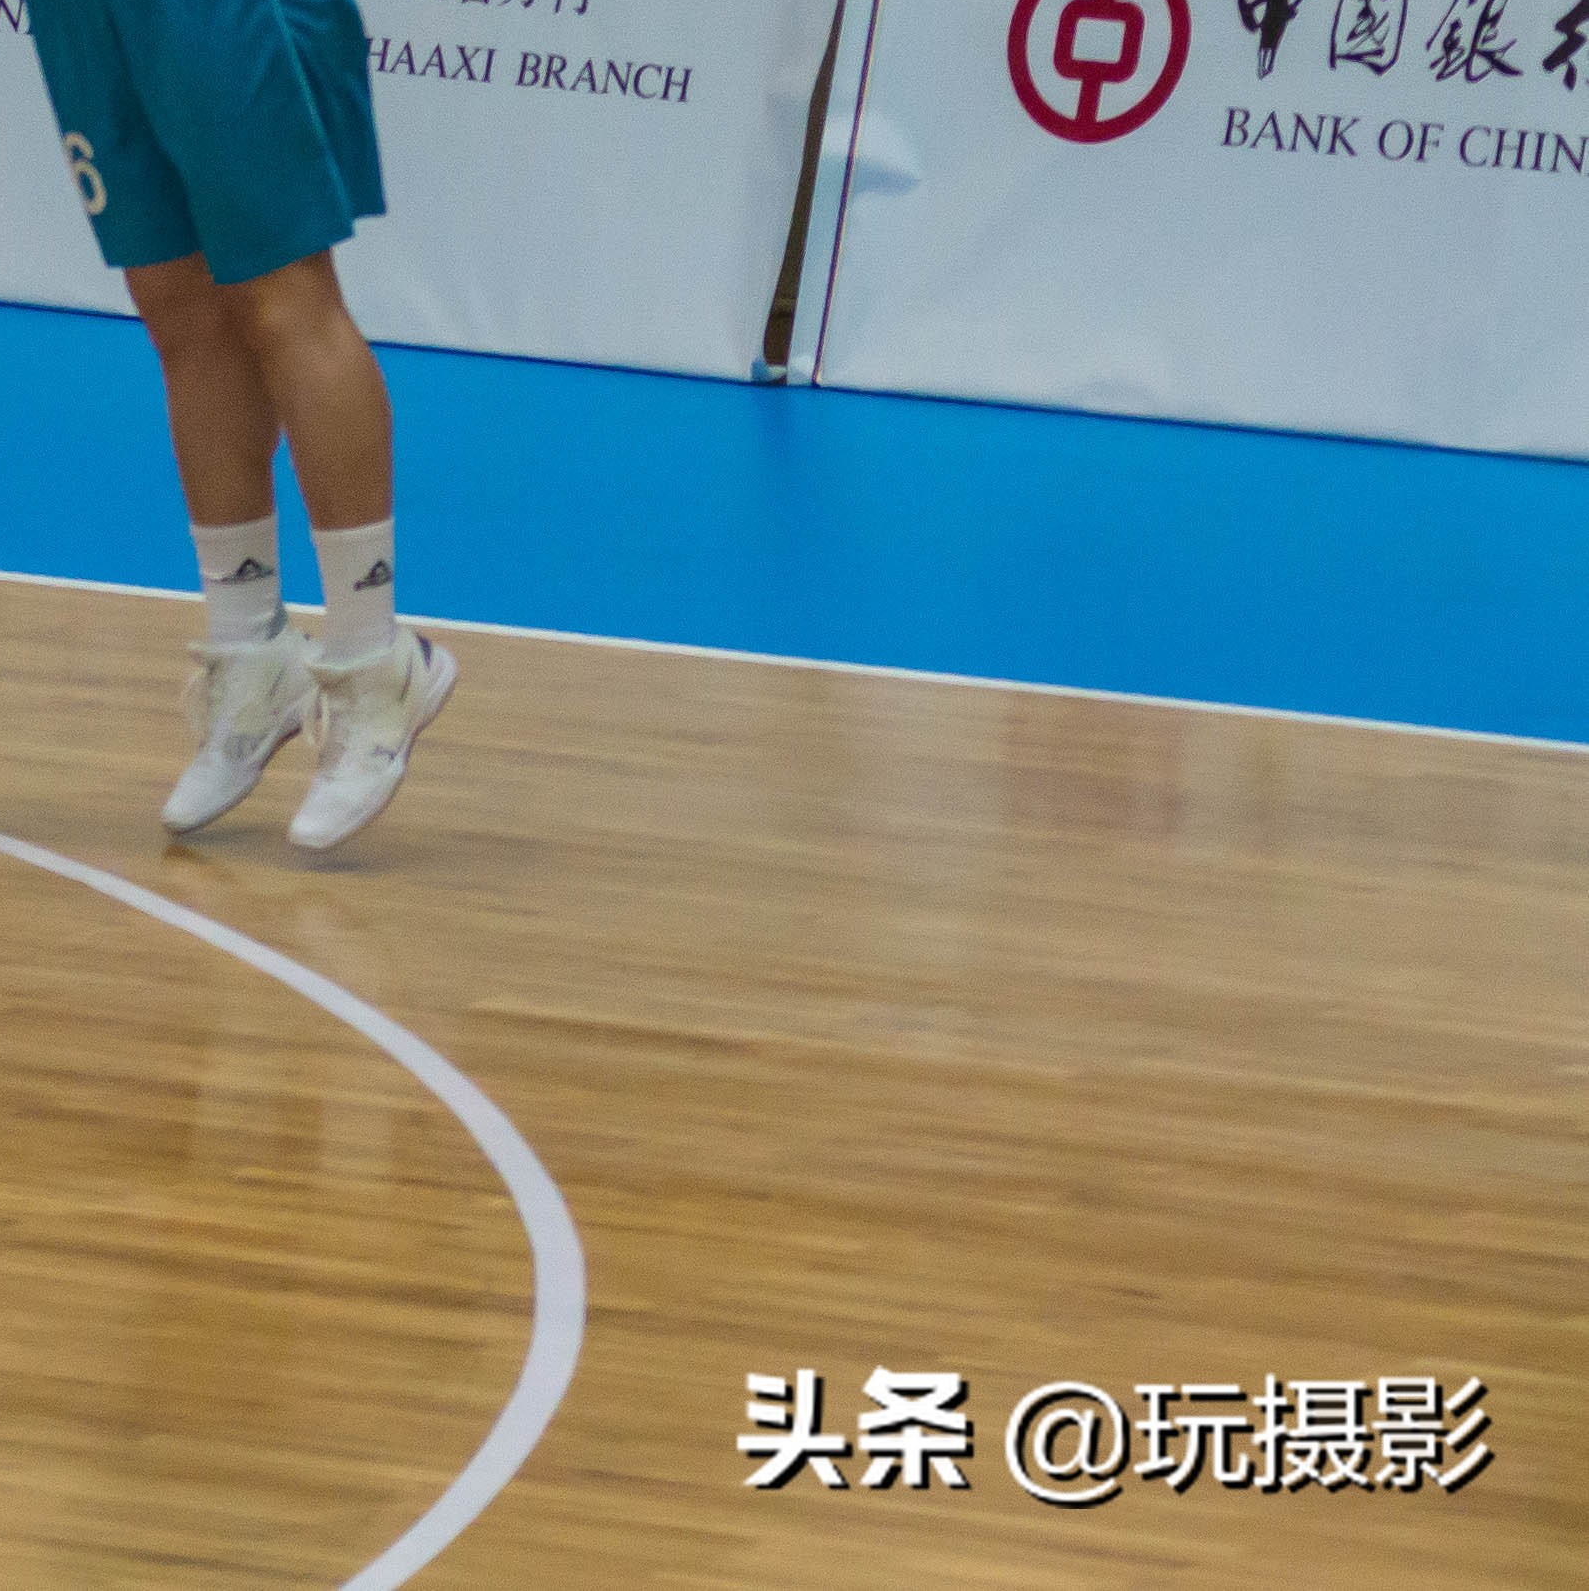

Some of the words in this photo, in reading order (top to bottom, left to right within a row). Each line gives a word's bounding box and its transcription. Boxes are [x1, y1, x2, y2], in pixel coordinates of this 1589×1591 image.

[515, 51, 692, 103] BRANCH
[1221, 107, 1360, 157] BANK
[1377, 120, 1445, 162] OF
[1458, 126, 1589, 175] CHIN
